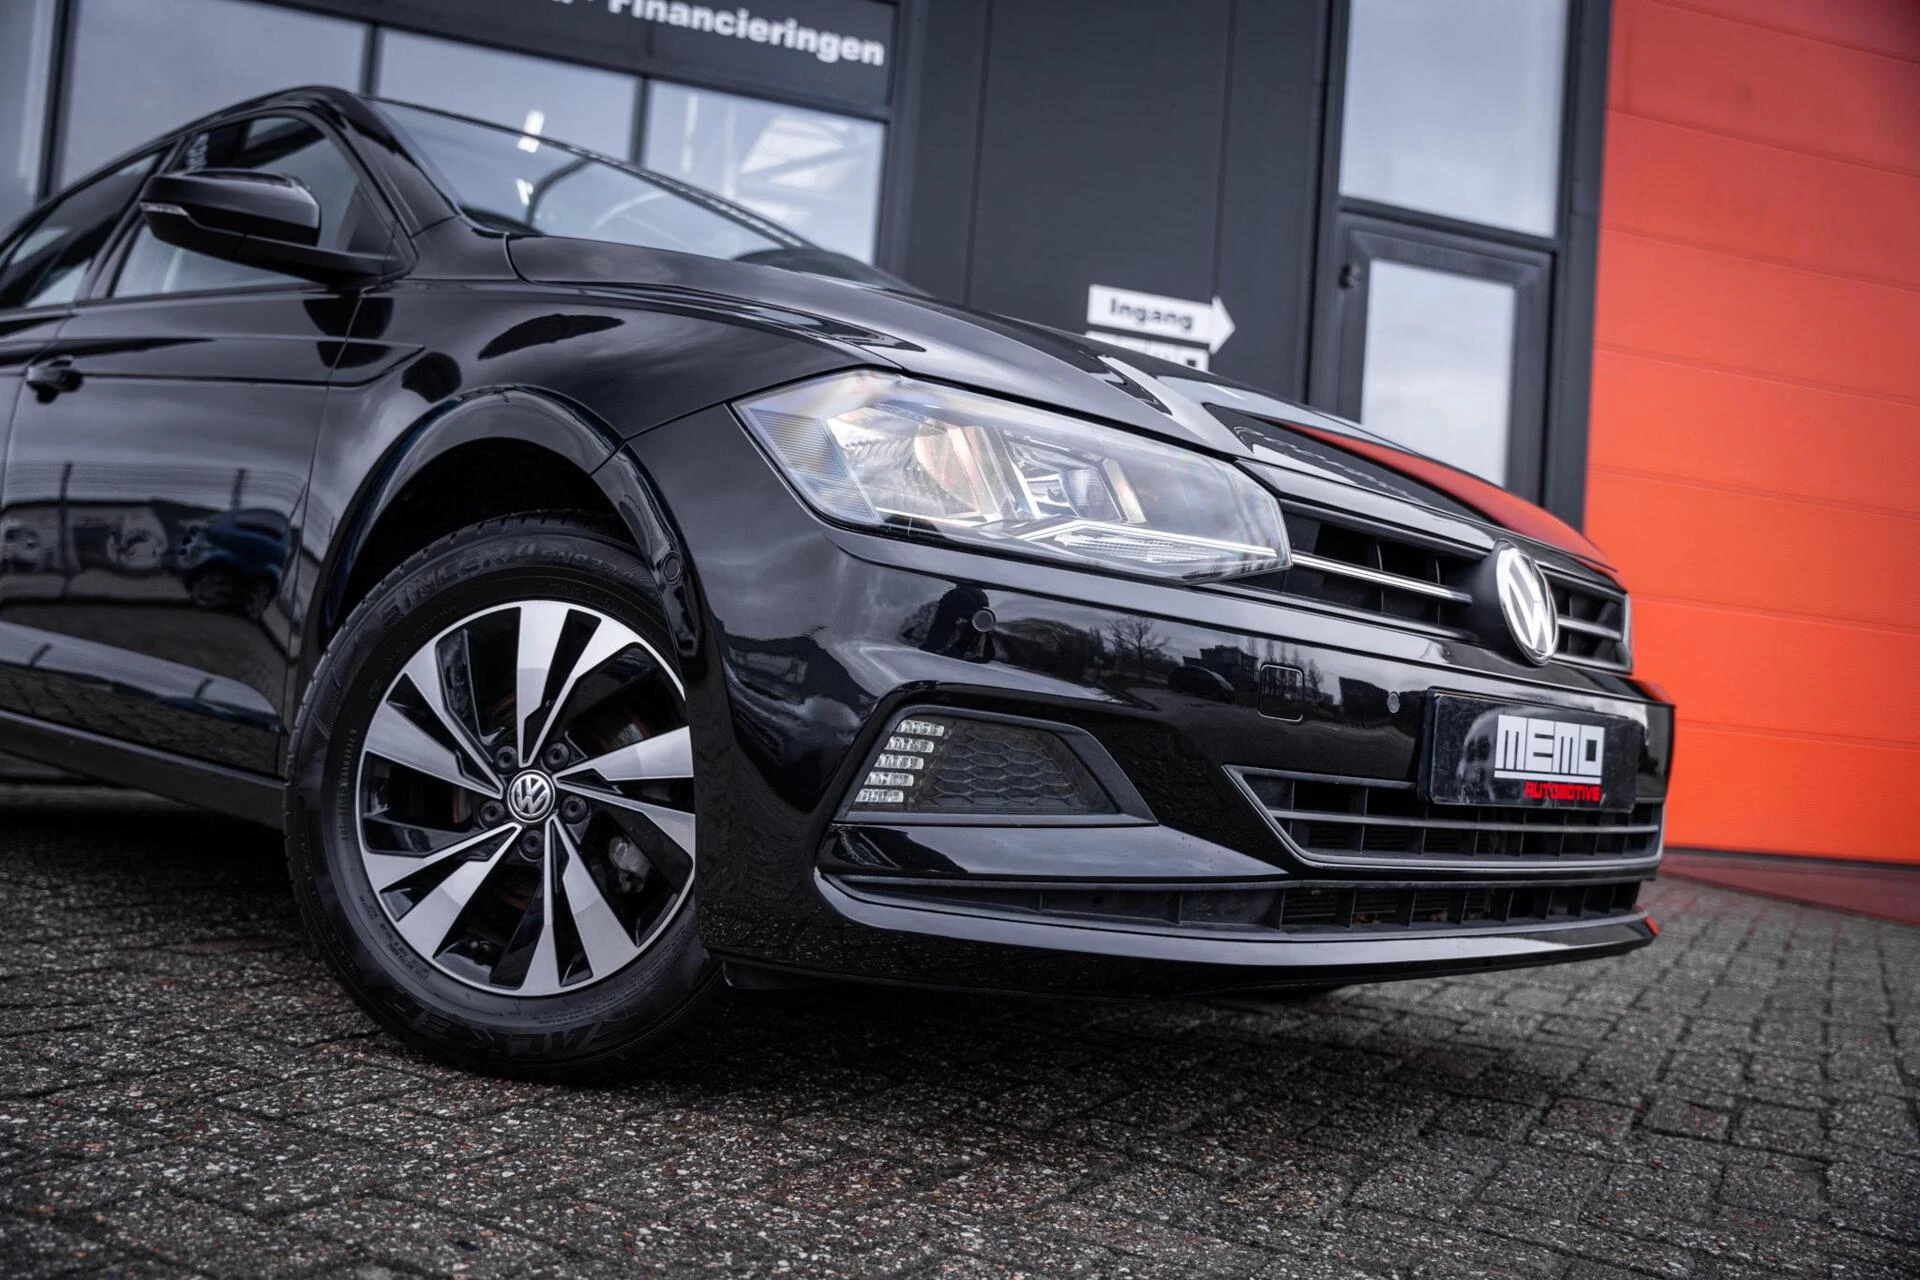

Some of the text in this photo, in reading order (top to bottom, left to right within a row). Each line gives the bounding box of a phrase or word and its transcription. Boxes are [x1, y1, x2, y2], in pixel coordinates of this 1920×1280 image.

[1110, 298, 1193, 331] Ingang
[1495, 714, 1605, 777] MEMO
[508, 770, 556, 823] VW
[1523, 781, 1602, 803] AUTOMOTIVE
